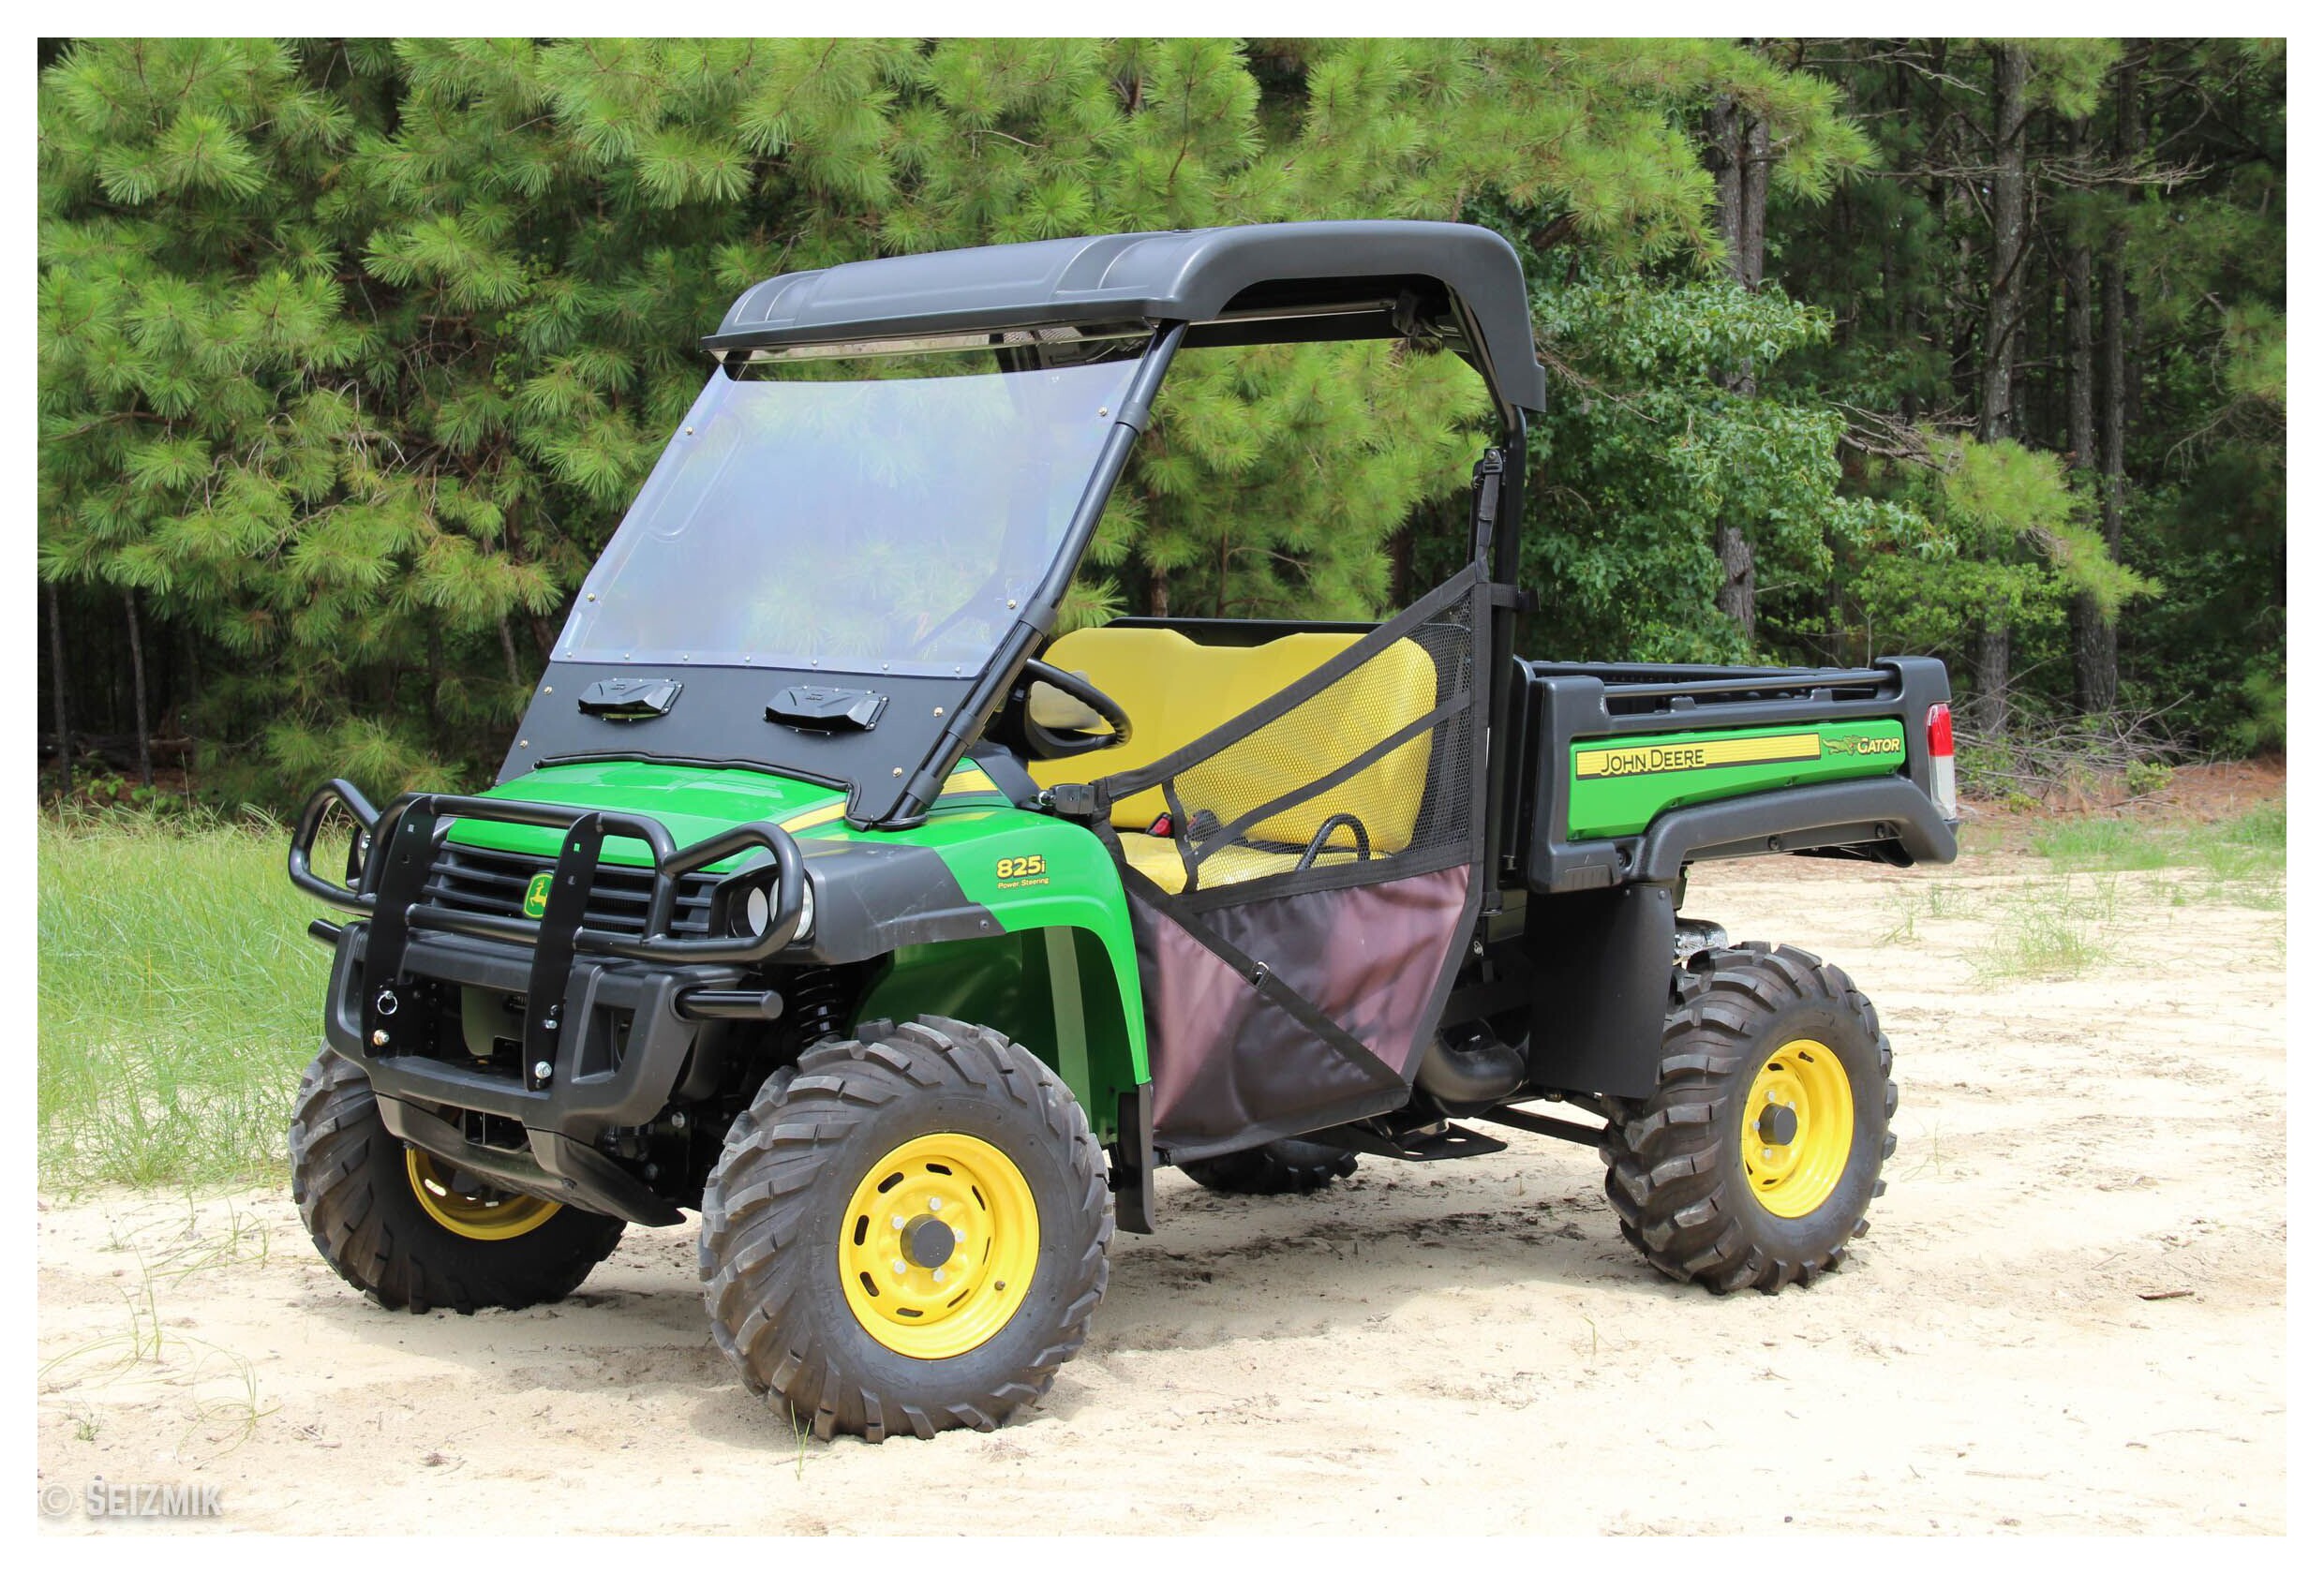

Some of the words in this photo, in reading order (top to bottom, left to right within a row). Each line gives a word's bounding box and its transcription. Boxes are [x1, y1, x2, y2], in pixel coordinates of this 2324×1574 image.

[1856, 736, 1900, 755] GATOR
[1601, 752, 1646, 773] JOHN
[1650, 749, 1705, 768] DEERE
[996, 854, 1046, 879] 825i
[1020, 877, 1050, 886] Steering
